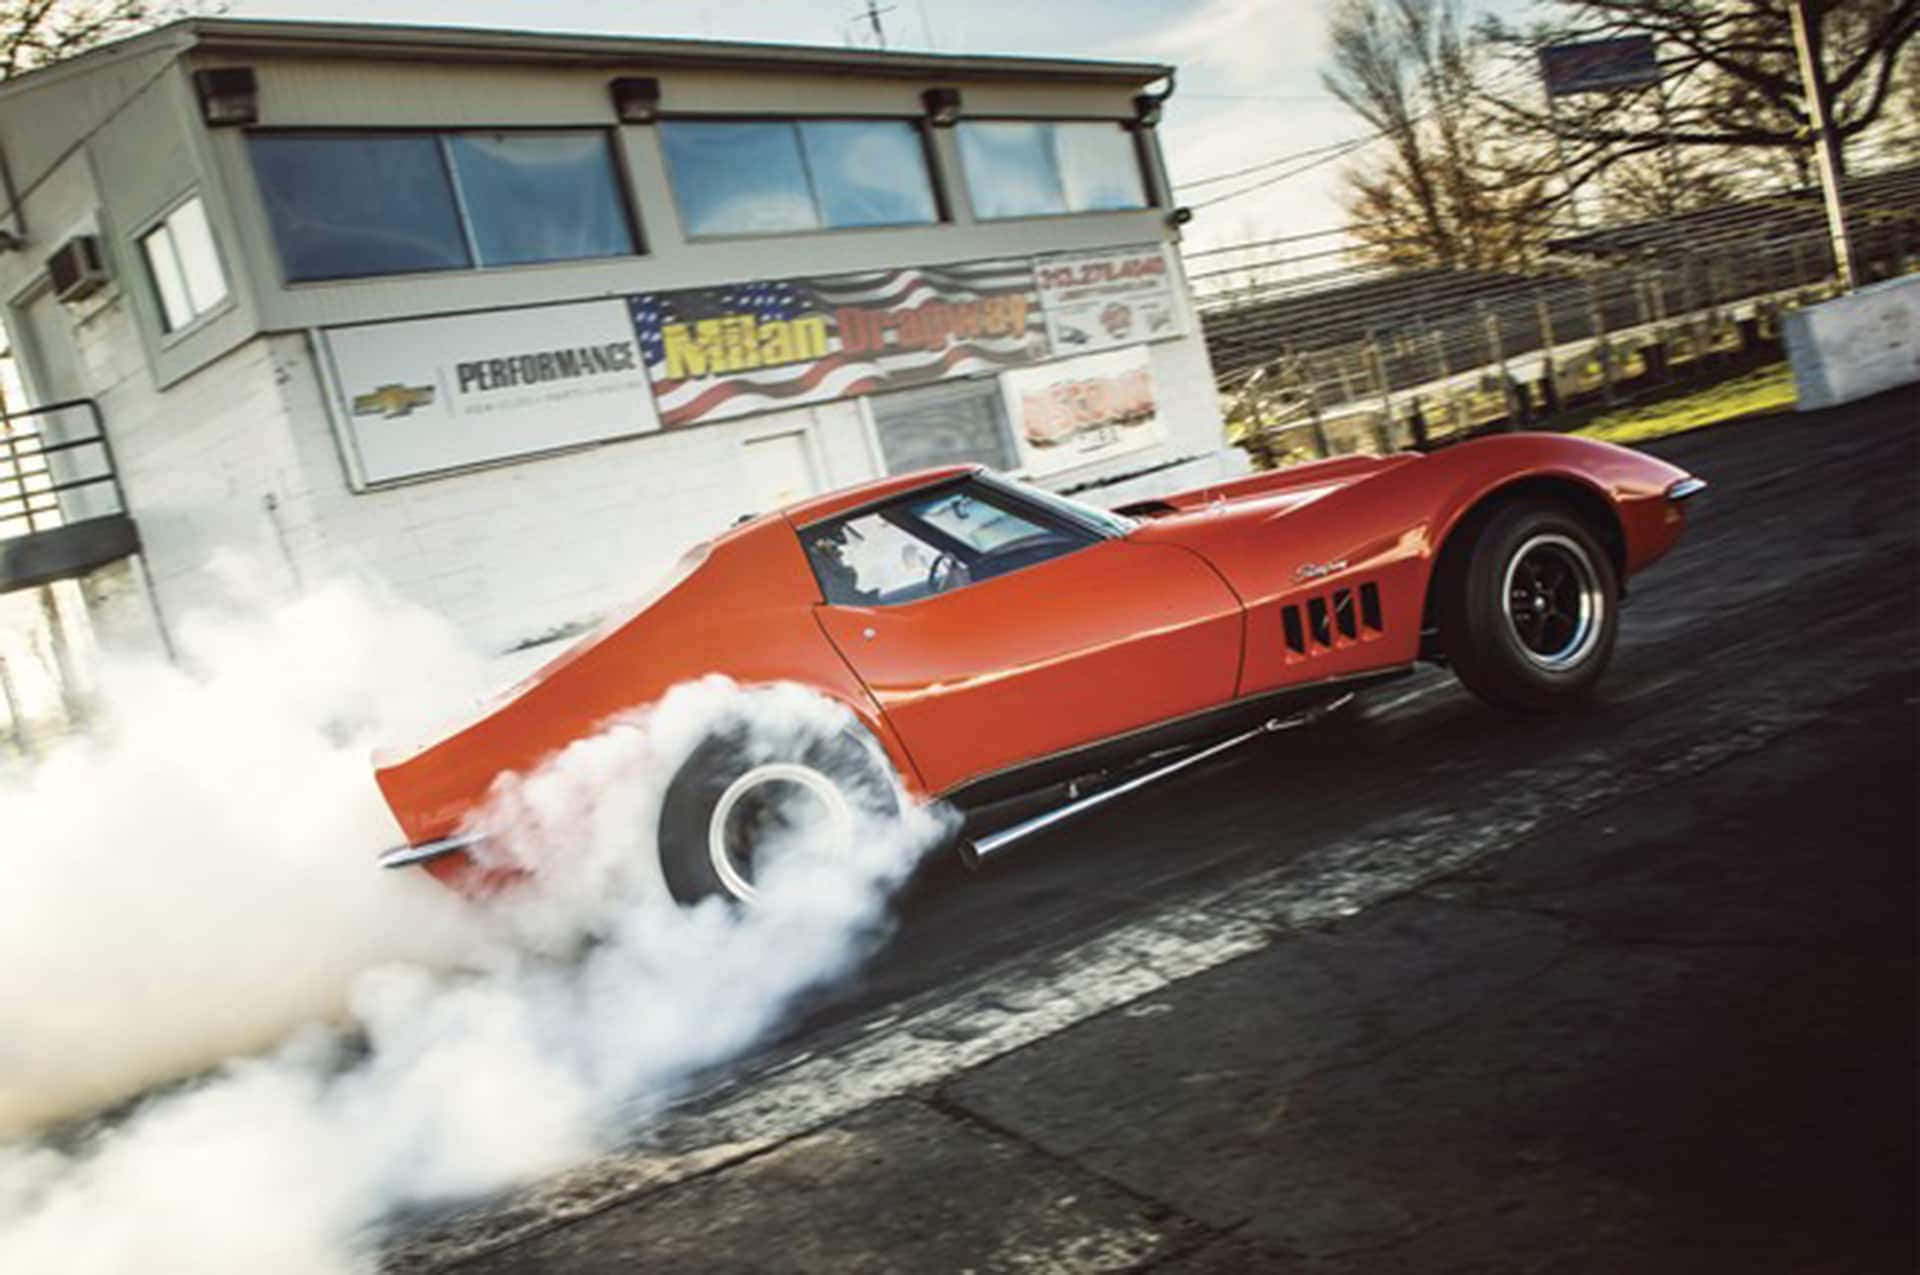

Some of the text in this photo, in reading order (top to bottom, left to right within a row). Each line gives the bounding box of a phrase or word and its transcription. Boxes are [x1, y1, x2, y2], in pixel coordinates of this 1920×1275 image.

[456, 341, 636, 394] PERFORMANCE
[662, 296, 1026, 379] Milan Dragway
